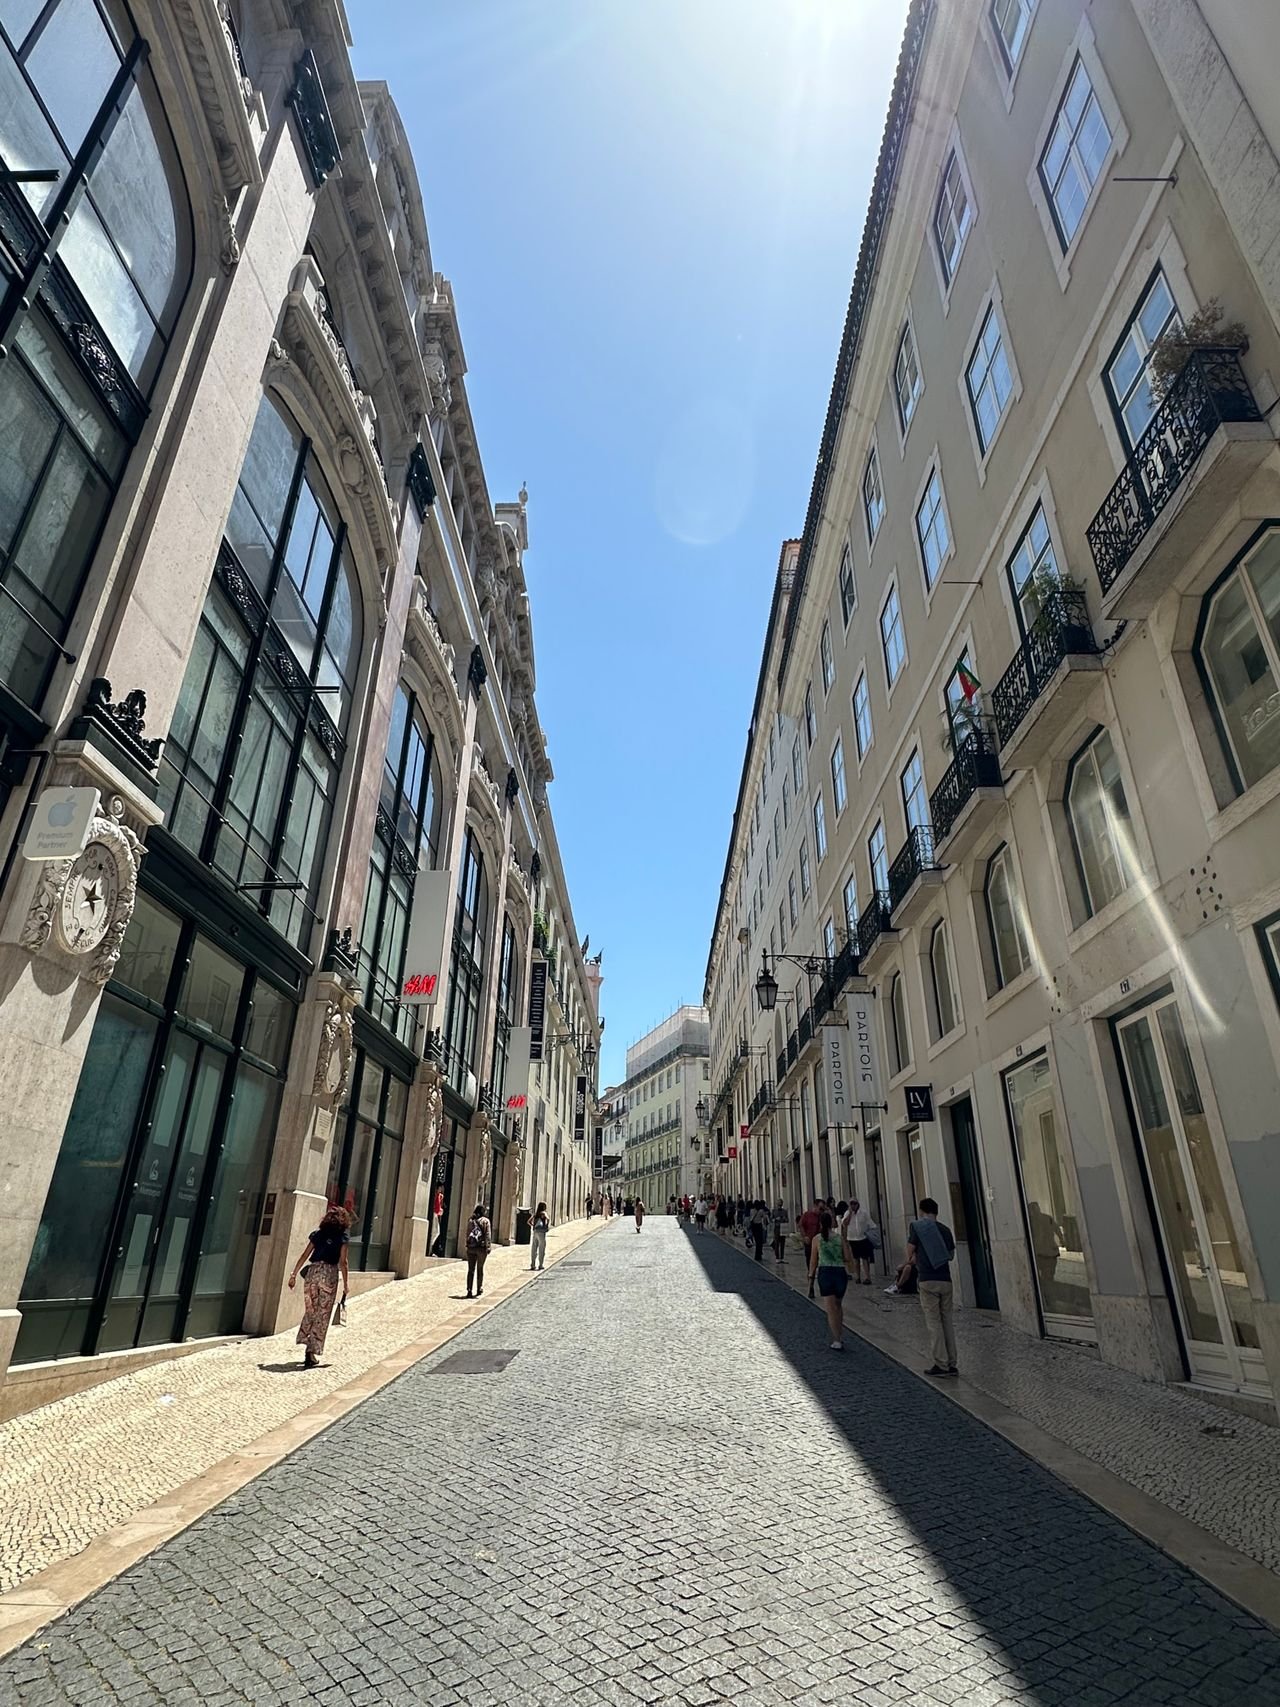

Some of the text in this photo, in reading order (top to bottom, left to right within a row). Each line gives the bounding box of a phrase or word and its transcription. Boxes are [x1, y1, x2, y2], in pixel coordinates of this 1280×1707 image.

[37, 841, 67, 849] Partner
[65, 868, 81, 909] SEMPRE
[404, 974, 437, 996] H&M
[856, 1011, 873, 1082] PARFOIS
[831, 1041, 844, 1105] PARFOIS
